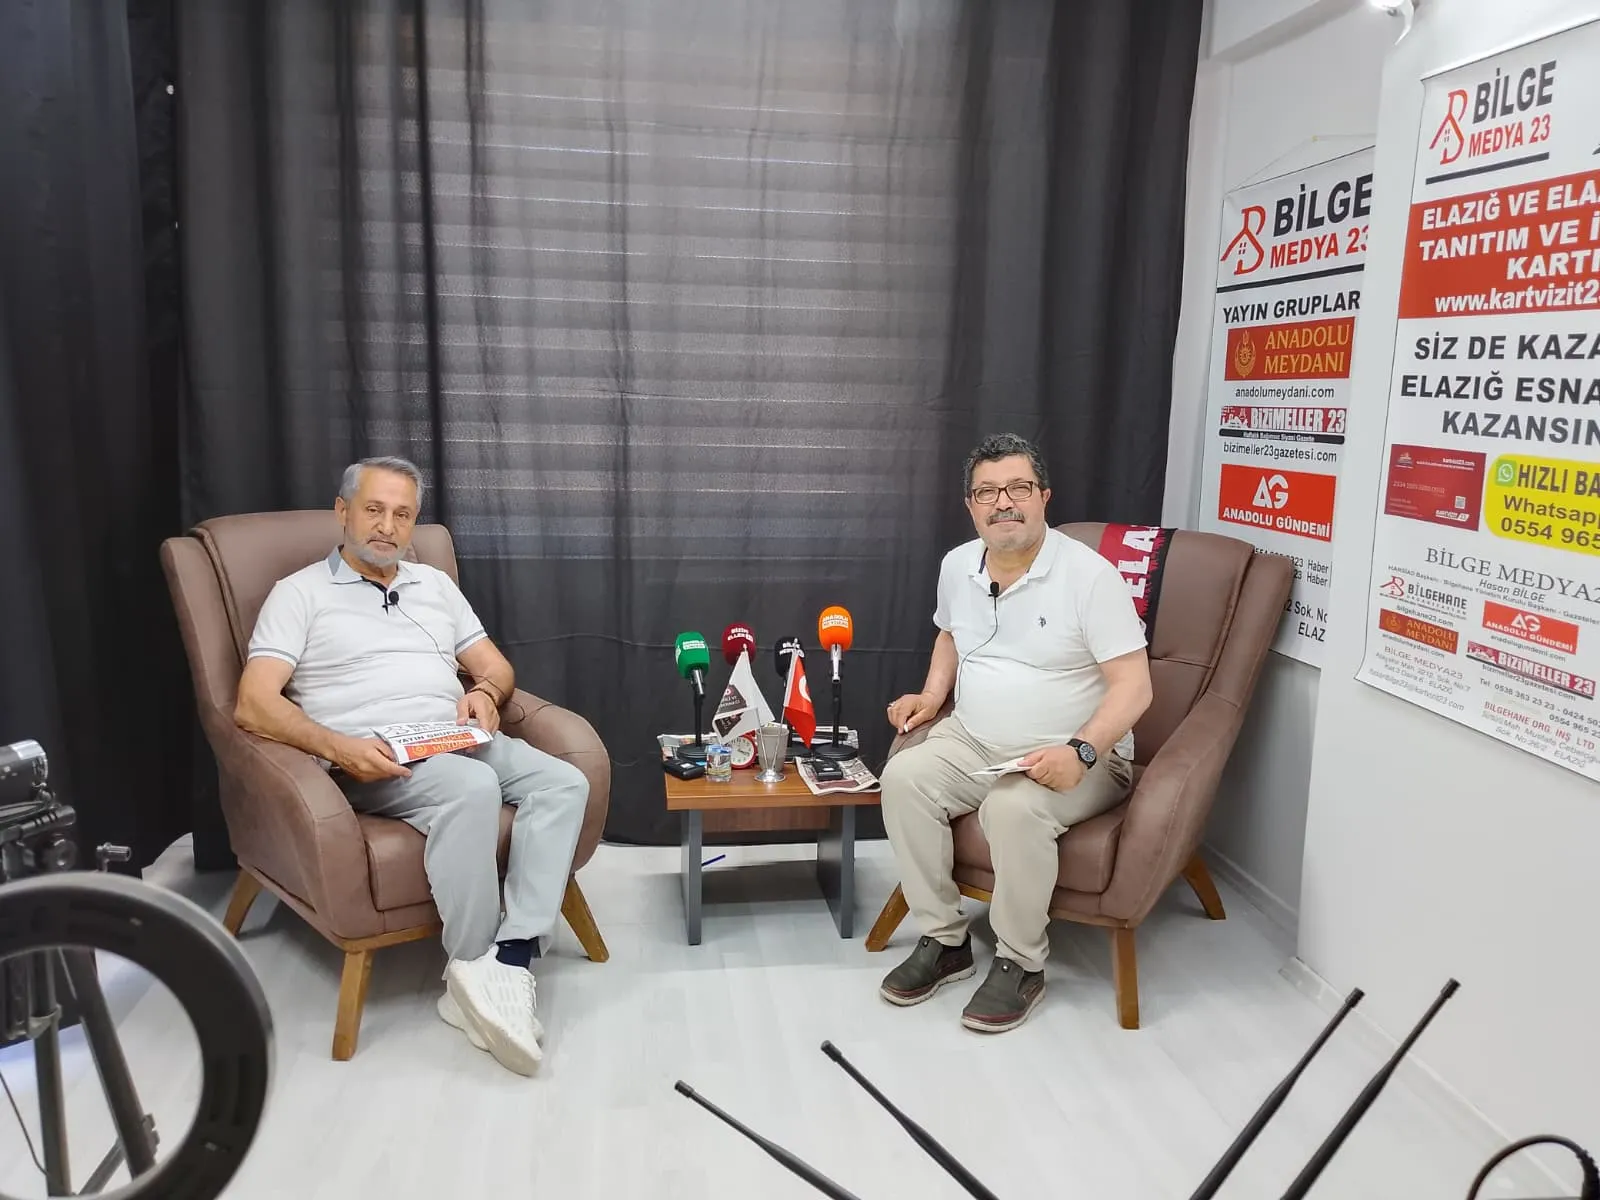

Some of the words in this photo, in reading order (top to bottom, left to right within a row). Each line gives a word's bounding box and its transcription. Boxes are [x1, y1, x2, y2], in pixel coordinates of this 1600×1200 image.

[1473, 60, 1557, 124] BİLGE
[1468, 121, 1523, 158] MEDYA
[1529, 113, 1551, 144] 23
[1273, 173, 1373, 237] BİLGE
[1422, 192, 1499, 230] ELAZIĞ
[1508, 190, 1540, 217] VE
[1546, 180, 1600, 211] ELA
[1270, 232, 1339, 268] MEDYA
[1419, 227, 1529, 261] TANITIM
[1539, 219, 1580, 246] VE
[1223, 302, 1268, 323] YAYIN
[1273, 290, 1361, 319] GRUPLAR
[1435, 278, 1600, 312] www.kartvizit2
[1264, 324, 1351, 350] ANADOLU
[1414, 331, 1459, 360] SİZ
[1468, 336, 1507, 360] DE
[1517, 333, 1600, 360] KAZA
[1264, 352, 1345, 375] MEYDANI
[1235, 386, 1335, 400] anadolumeydani.com
[1400, 370, 1504, 401] ELAZIĞ
[1515, 377, 1600, 405] ESNA
[1327, 409, 1346, 433] 23
[1442, 411, 1600, 445] KAZANSIN
[1223, 442, 1337, 462] bizimeller23gazetesi.com
[1252, 474, 1289, 510] AG
[1517, 463, 1568, 493] HIZLI
[1574, 470, 1600, 498] BA
[1223, 507, 1273, 526] ANADOLU
[1276, 516, 1331, 538] GÜNDEMİ
[1503, 494, 1600, 530] Whatsap
[1501, 517, 1553, 540] 0554
[1561, 528, 1600, 549] 965
[1307, 559, 1329, 574] Haber
[1425, 547, 1492, 577] BİLGE
[1306, 571, 1328, 587] Haber
[1480, 578, 1510, 595] Hasan
[1513, 587, 1546, 604] BİLGE
[1294, 600, 1314, 619] Sok.
[1408, 582, 1468, 610] BİLGEHANE
[1298, 621, 1326, 642] ELAZ
[1406, 629, 1454, 651] MEYDANI
[1407, 619, 1457, 640] ANADOLU
[1486, 621, 1527, 637] ANADOLU
[1414, 656, 1463, 680] MEDYA23
[1574, 677, 1594, 696] 23
[1532, 697, 1543, 706] 23
[1544, 701, 1555, 711] 23
[1562, 708, 1585, 721] 0424
[1549, 713, 1570, 727] 0554
